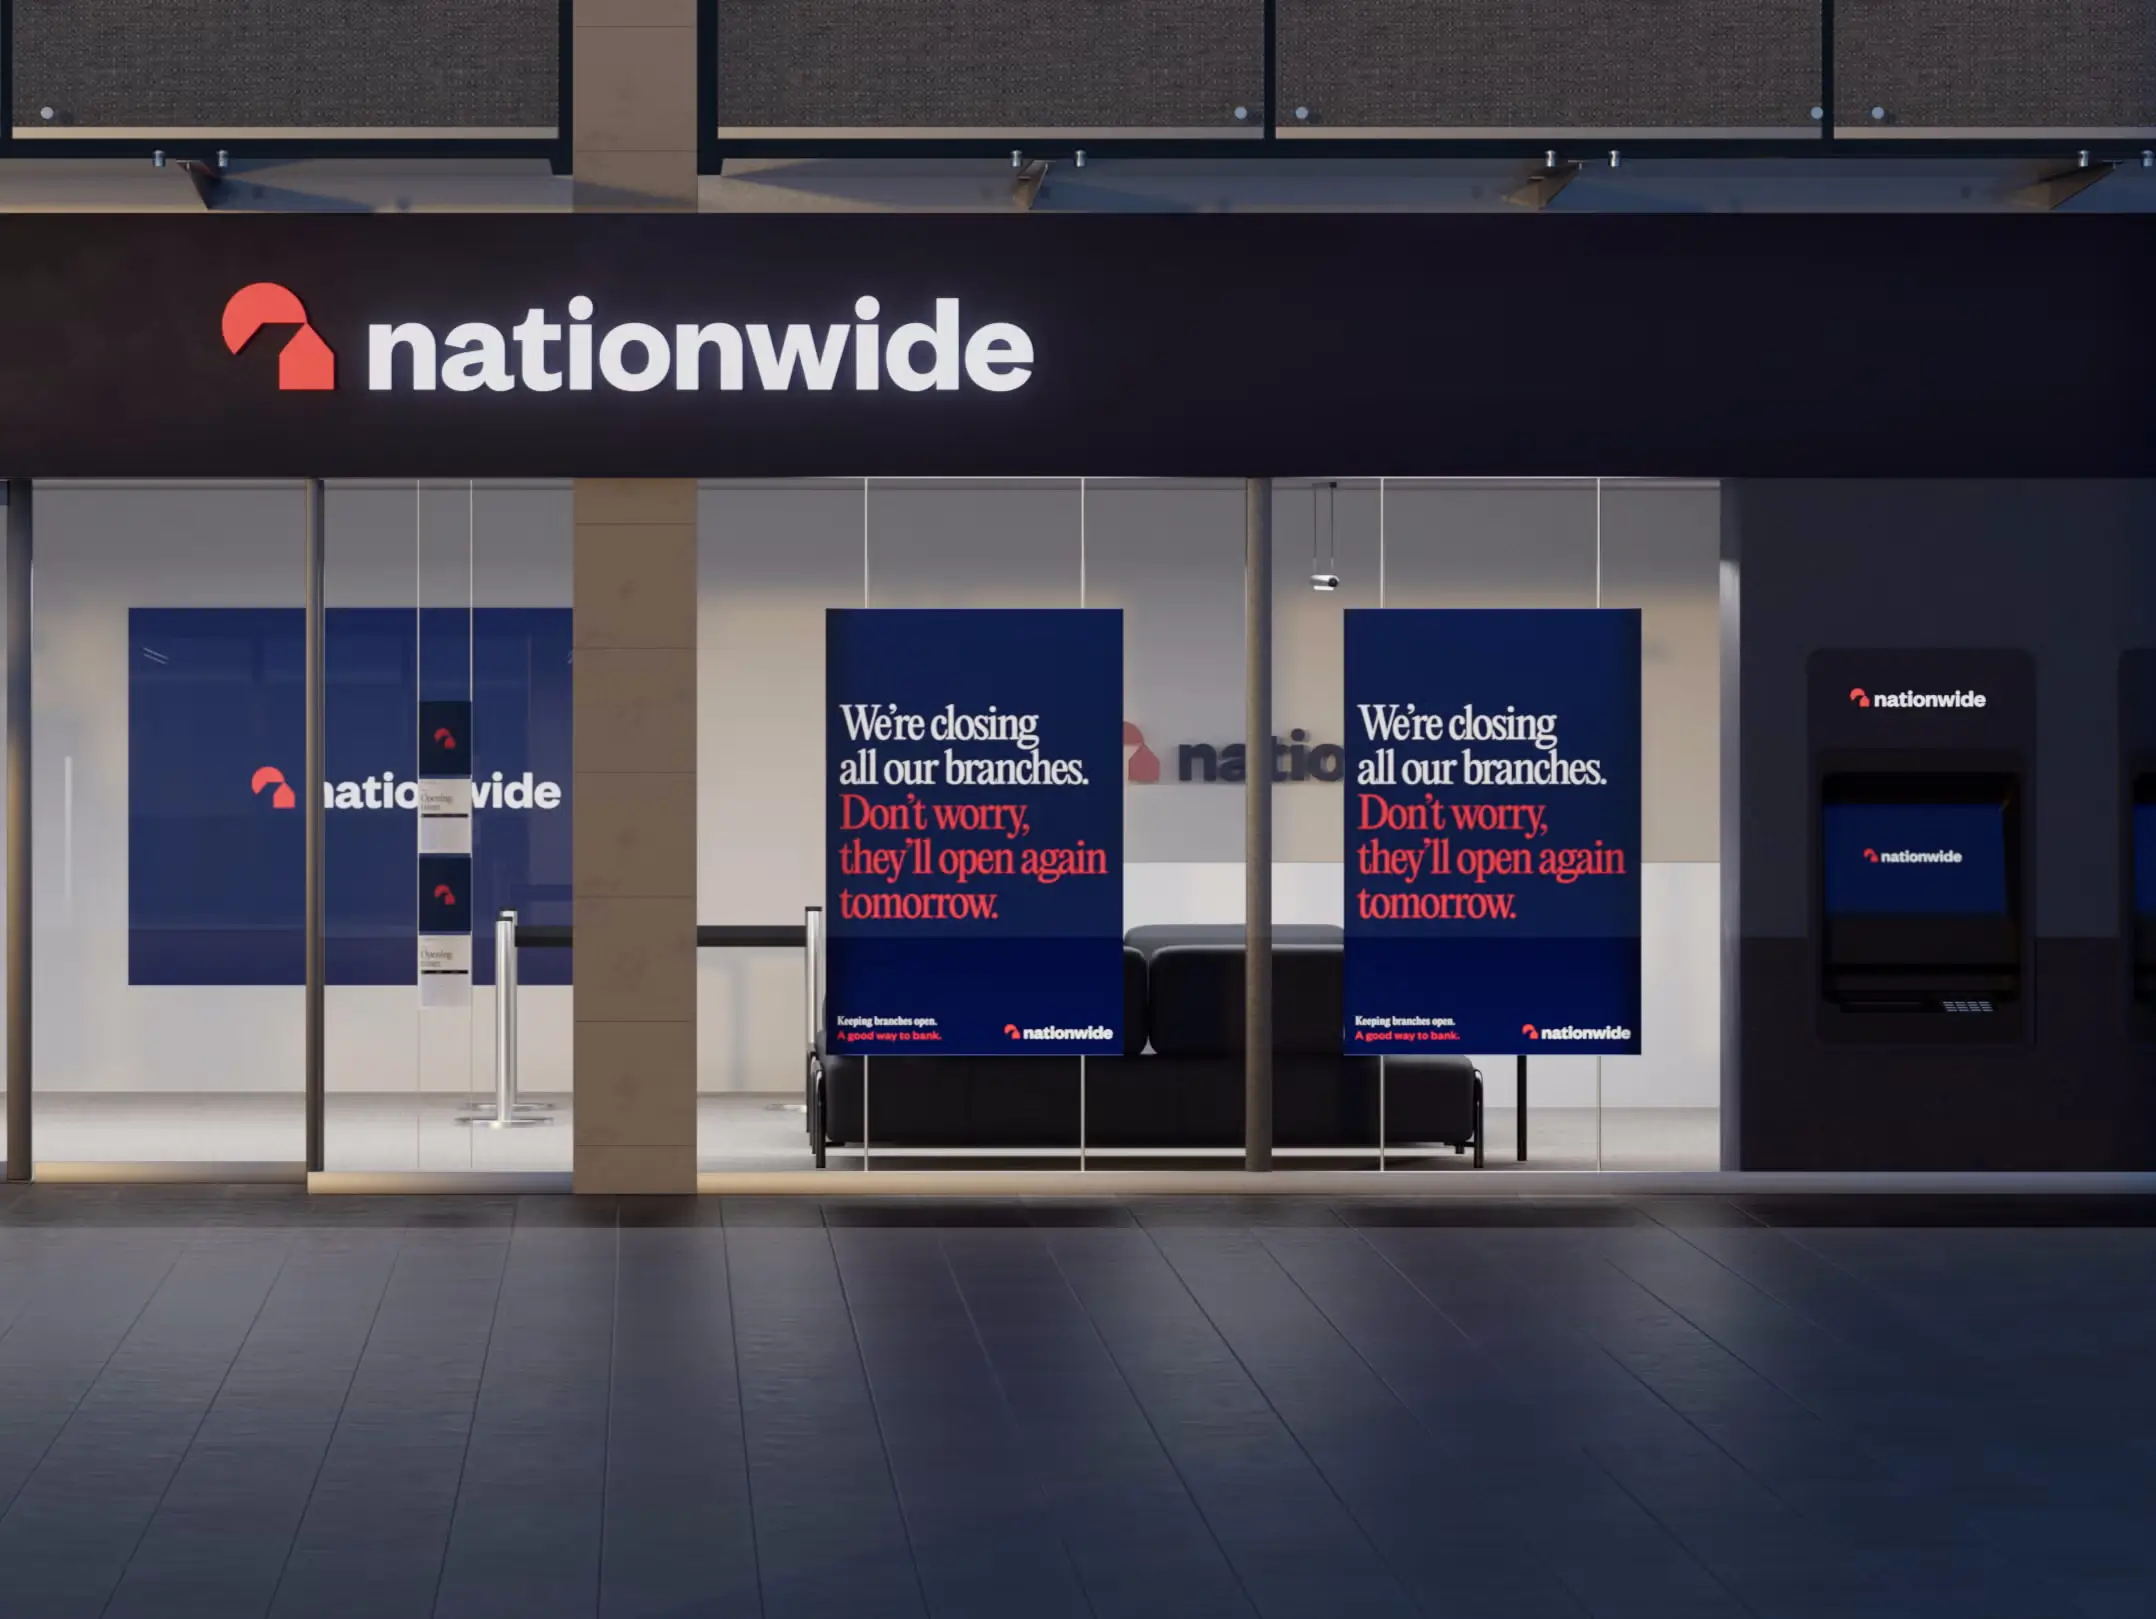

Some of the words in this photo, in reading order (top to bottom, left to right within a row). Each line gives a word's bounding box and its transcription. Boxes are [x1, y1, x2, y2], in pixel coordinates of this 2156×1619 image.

[368, 295, 1034, 392] nationwide
[1873, 688, 1987, 708] nationwide
[840, 703, 925, 741] We’re
[931, 704, 1039, 750] closing
[1357, 704, 1443, 741] We’re
[1449, 704, 1557, 750] closing
[840, 748, 879, 785] all
[884, 760, 940, 785] our
[944, 748, 1089, 785] branches.
[1357, 748, 1397, 785] all
[1402, 760, 1458, 785] our
[1462, 748, 1607, 785] branches.
[839, 793, 928, 830] Don’t
[933, 805, 1029, 839] worry,
[1357, 793, 1446, 830] Don’t
[1450, 805, 1547, 839] worry,
[840, 838, 932, 883] they’ll
[939, 848, 1016, 883] open
[1021, 840, 1109, 883] again
[1357, 838, 1450, 883] they’ll
[1457, 848, 1534, 883] open
[1539, 840, 1626, 883] again
[1880, 849, 1963, 864] nationwide
[840, 889, 998, 919] tomorrow.
[1357, 889, 1516, 919] tomorrow.
[837, 1015, 873, 1027] Keeping
[874, 1015, 912, 1027] branches
[913, 1016, 938, 1028] open.
[837, 1030, 846, 1041] A
[847, 1031, 874, 1043] good
[876, 1032, 898, 1043] way
[899, 1031, 911, 1041] to
[912, 1030, 942, 1042] bank.
[1022, 1024, 1114, 1041] nationwide
[1355, 1015, 1391, 1027] Keeping
[1392, 1015, 1430, 1027] branches
[1432, 1016, 1456, 1028] open.
[1355, 1030, 1364, 1041] A
[1365, 1031, 1391, 1043] good
[1394, 1032, 1416, 1043] way
[1417, 1031, 1429, 1041] to
[1431, 1030, 1461, 1042] bank.
[1540, 1024, 1632, 1041] nationwide
